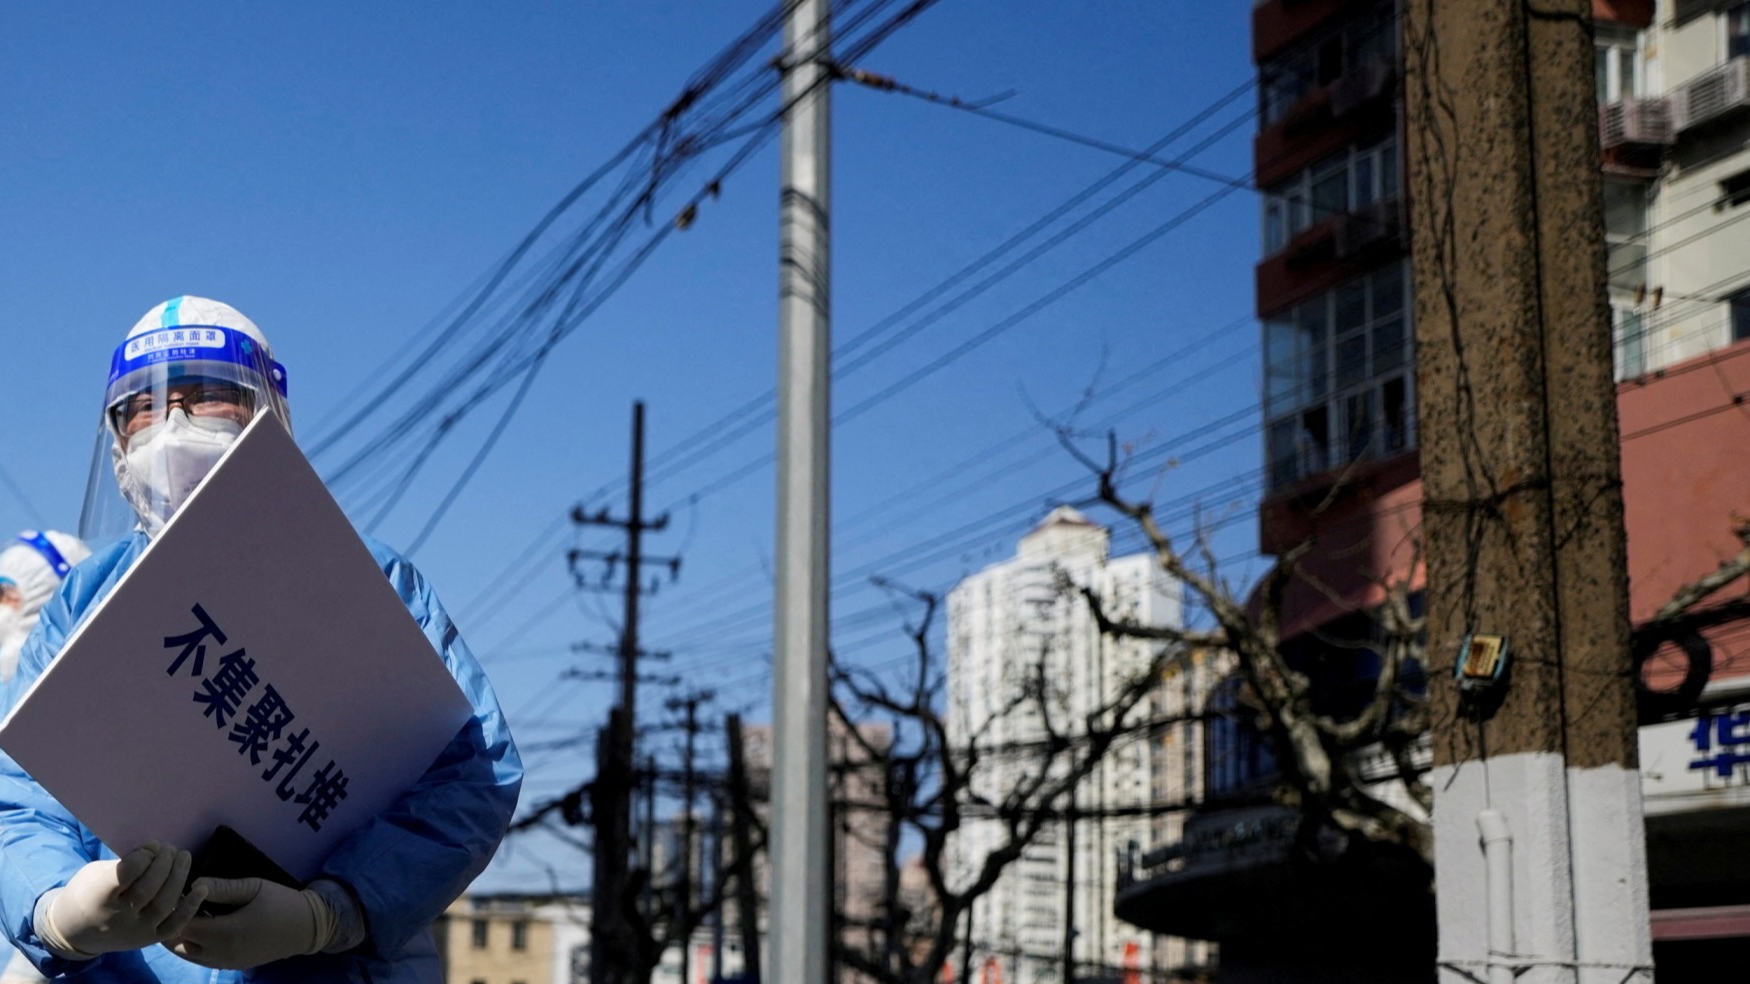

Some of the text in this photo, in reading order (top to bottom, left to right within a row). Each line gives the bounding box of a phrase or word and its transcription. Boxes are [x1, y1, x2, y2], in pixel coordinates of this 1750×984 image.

[131, 330, 216, 353] 医用隔离面罩
[164, 602, 349, 833] 不集聚扎堆
